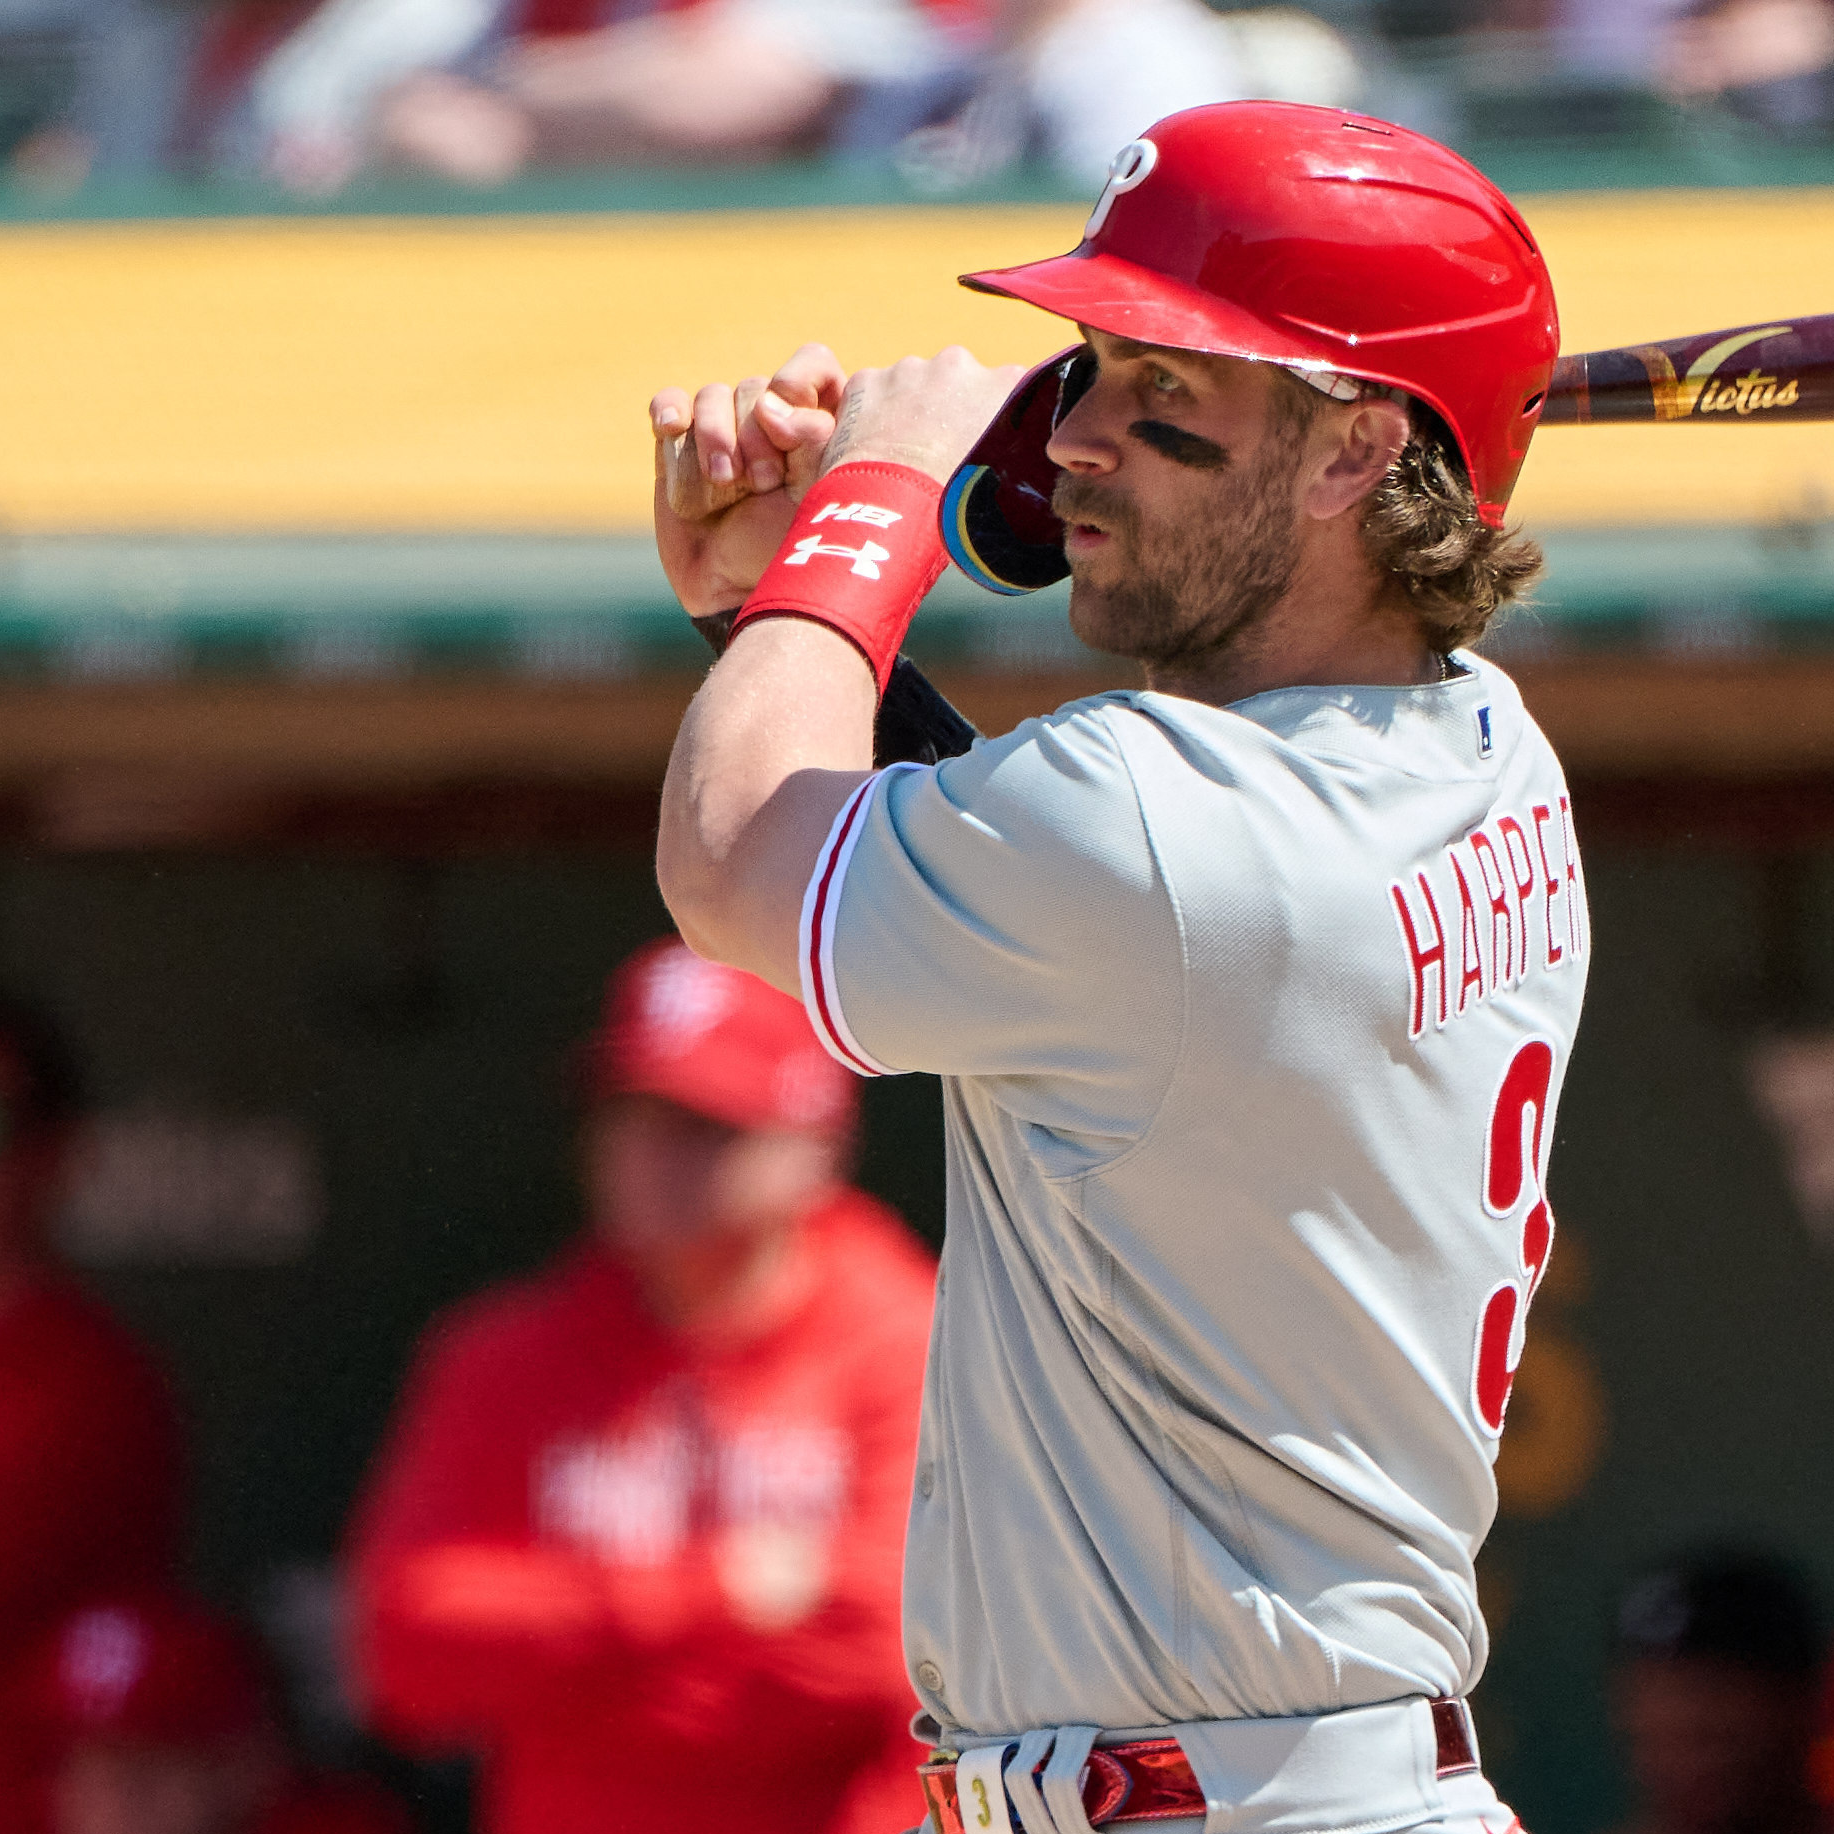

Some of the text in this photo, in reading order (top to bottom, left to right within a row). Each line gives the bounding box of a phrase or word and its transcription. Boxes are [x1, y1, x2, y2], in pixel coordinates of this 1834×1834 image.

[1633, 325, 1800, 421] Victus
[1472, 1032, 1557, 1440] 3
[971, 1776, 991, 1828] 3
